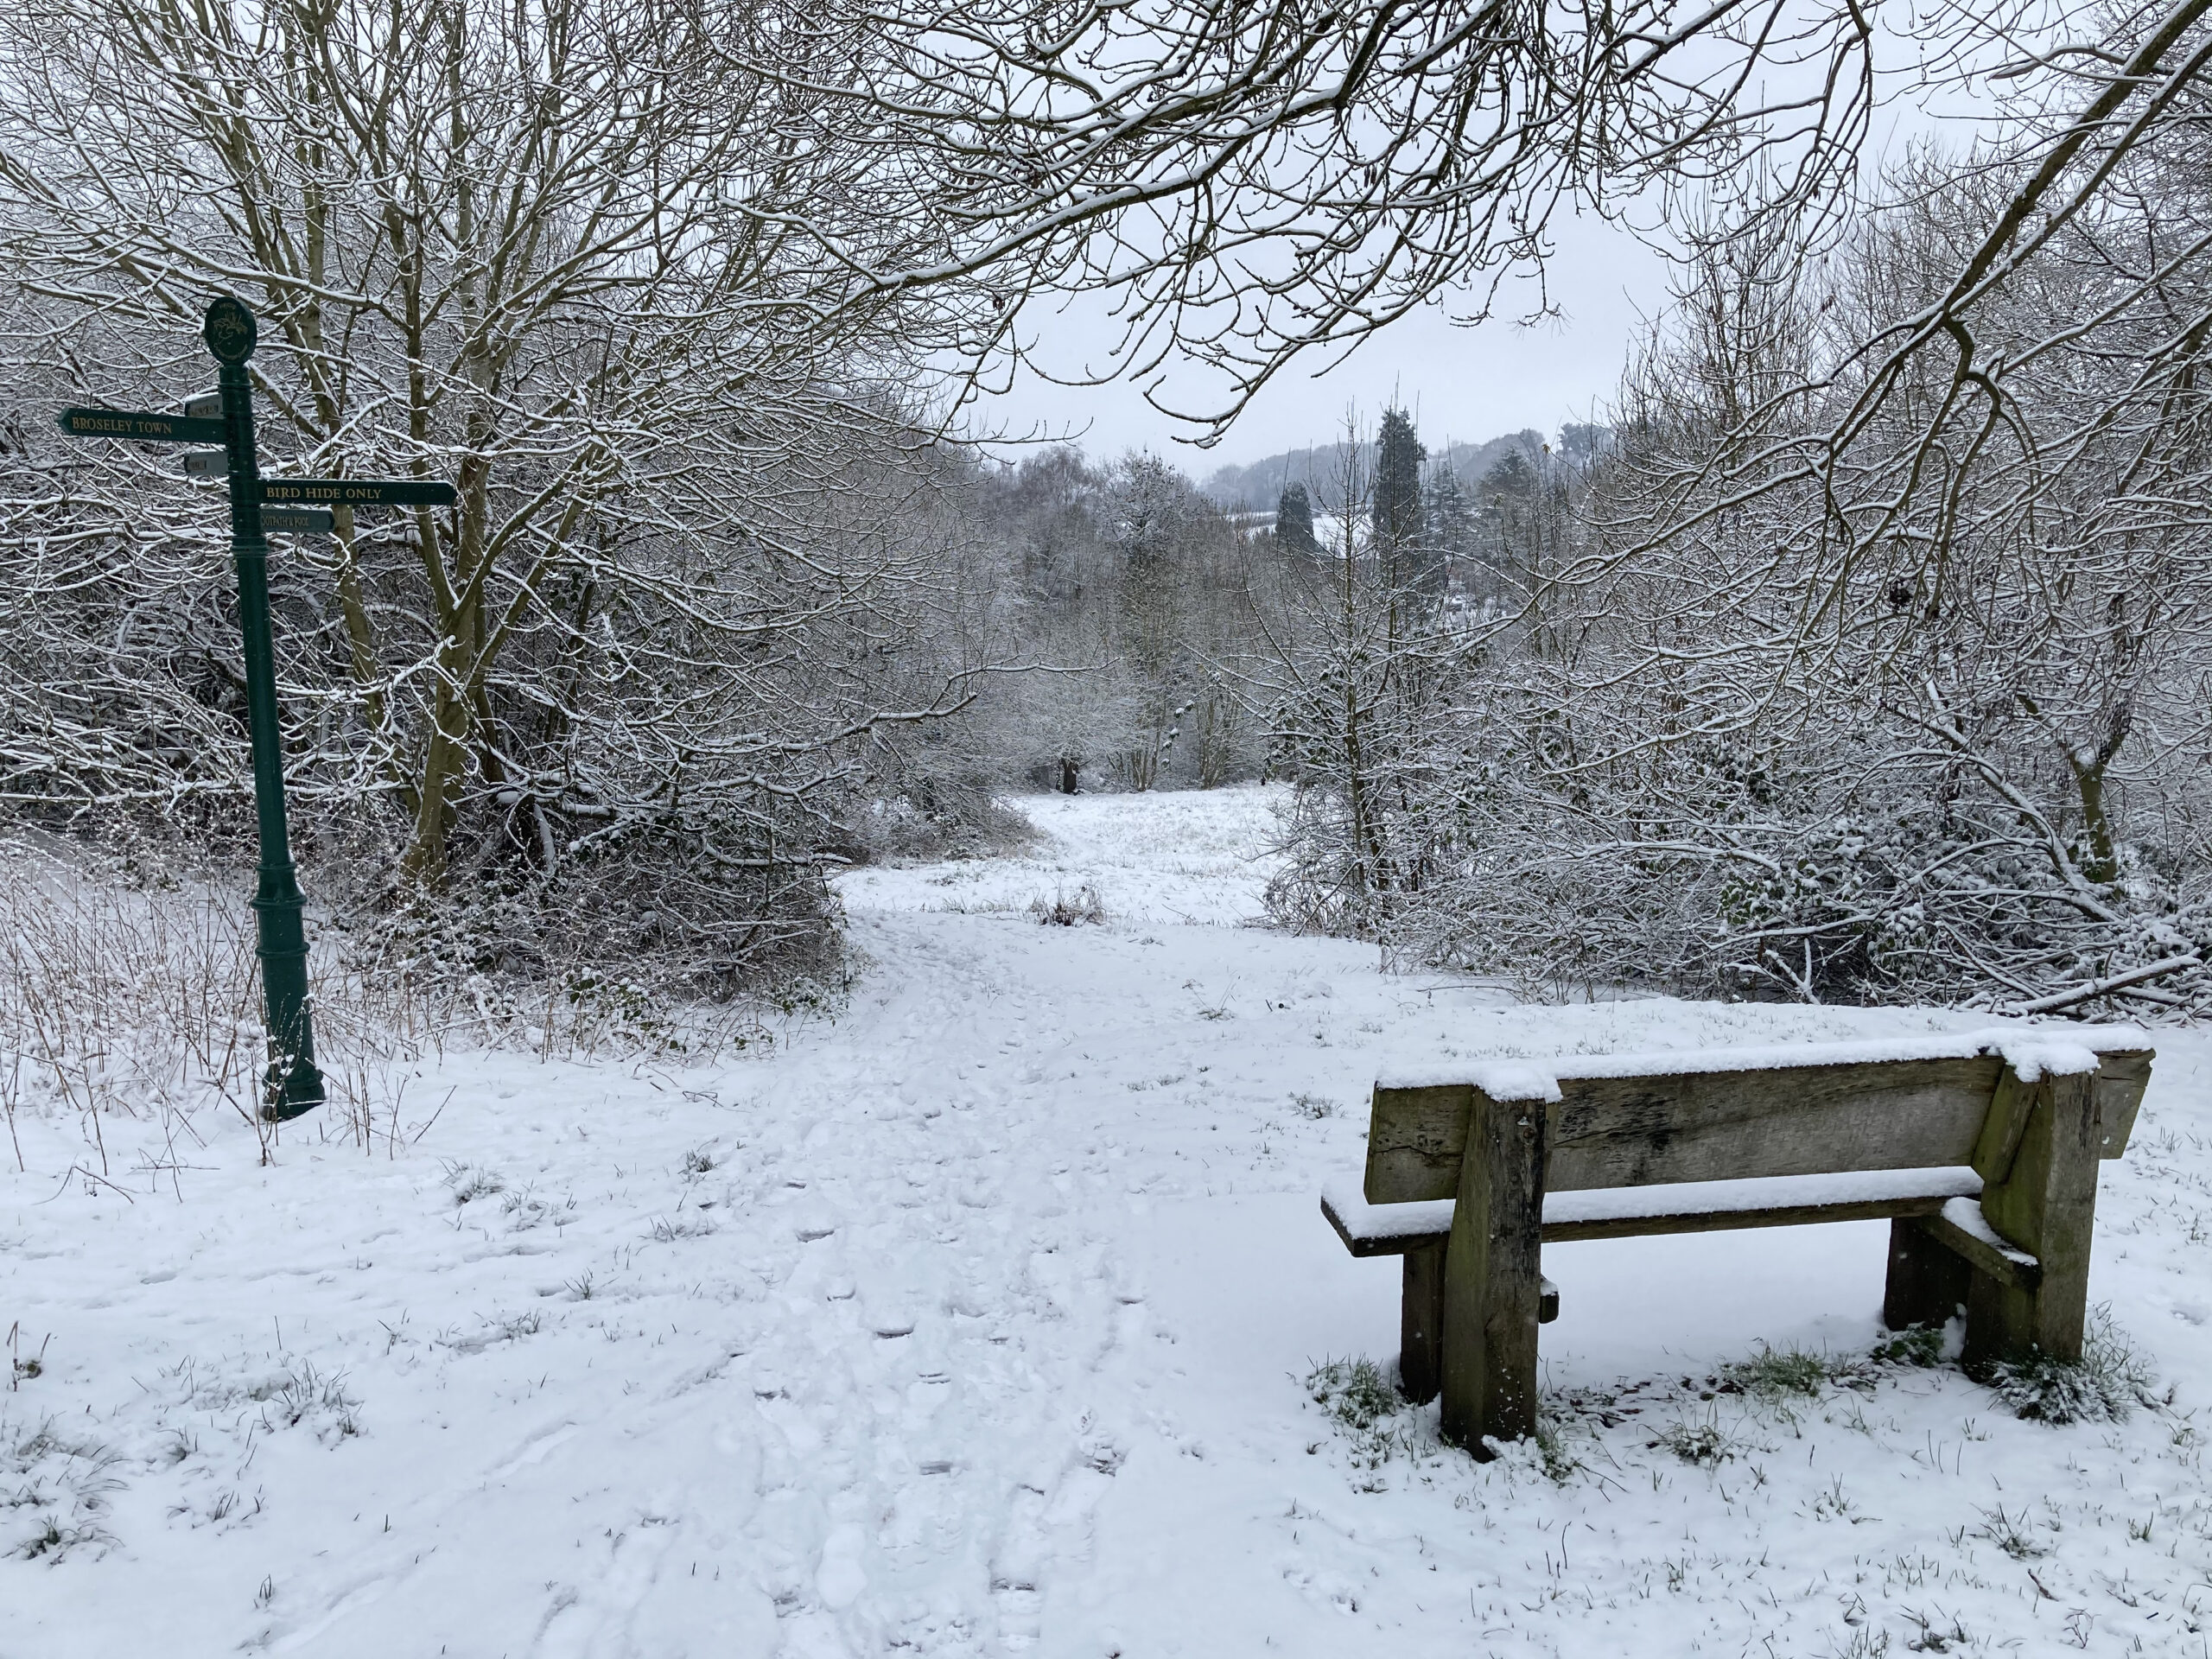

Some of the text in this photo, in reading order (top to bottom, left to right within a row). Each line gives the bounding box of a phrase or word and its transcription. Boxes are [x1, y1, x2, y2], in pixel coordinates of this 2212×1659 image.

[72, 416, 173, 435] BROSELEY TOWN
[266, 486, 382, 499] BIRD HIDE ONLY
[261, 516, 289, 527] OOTPATH
